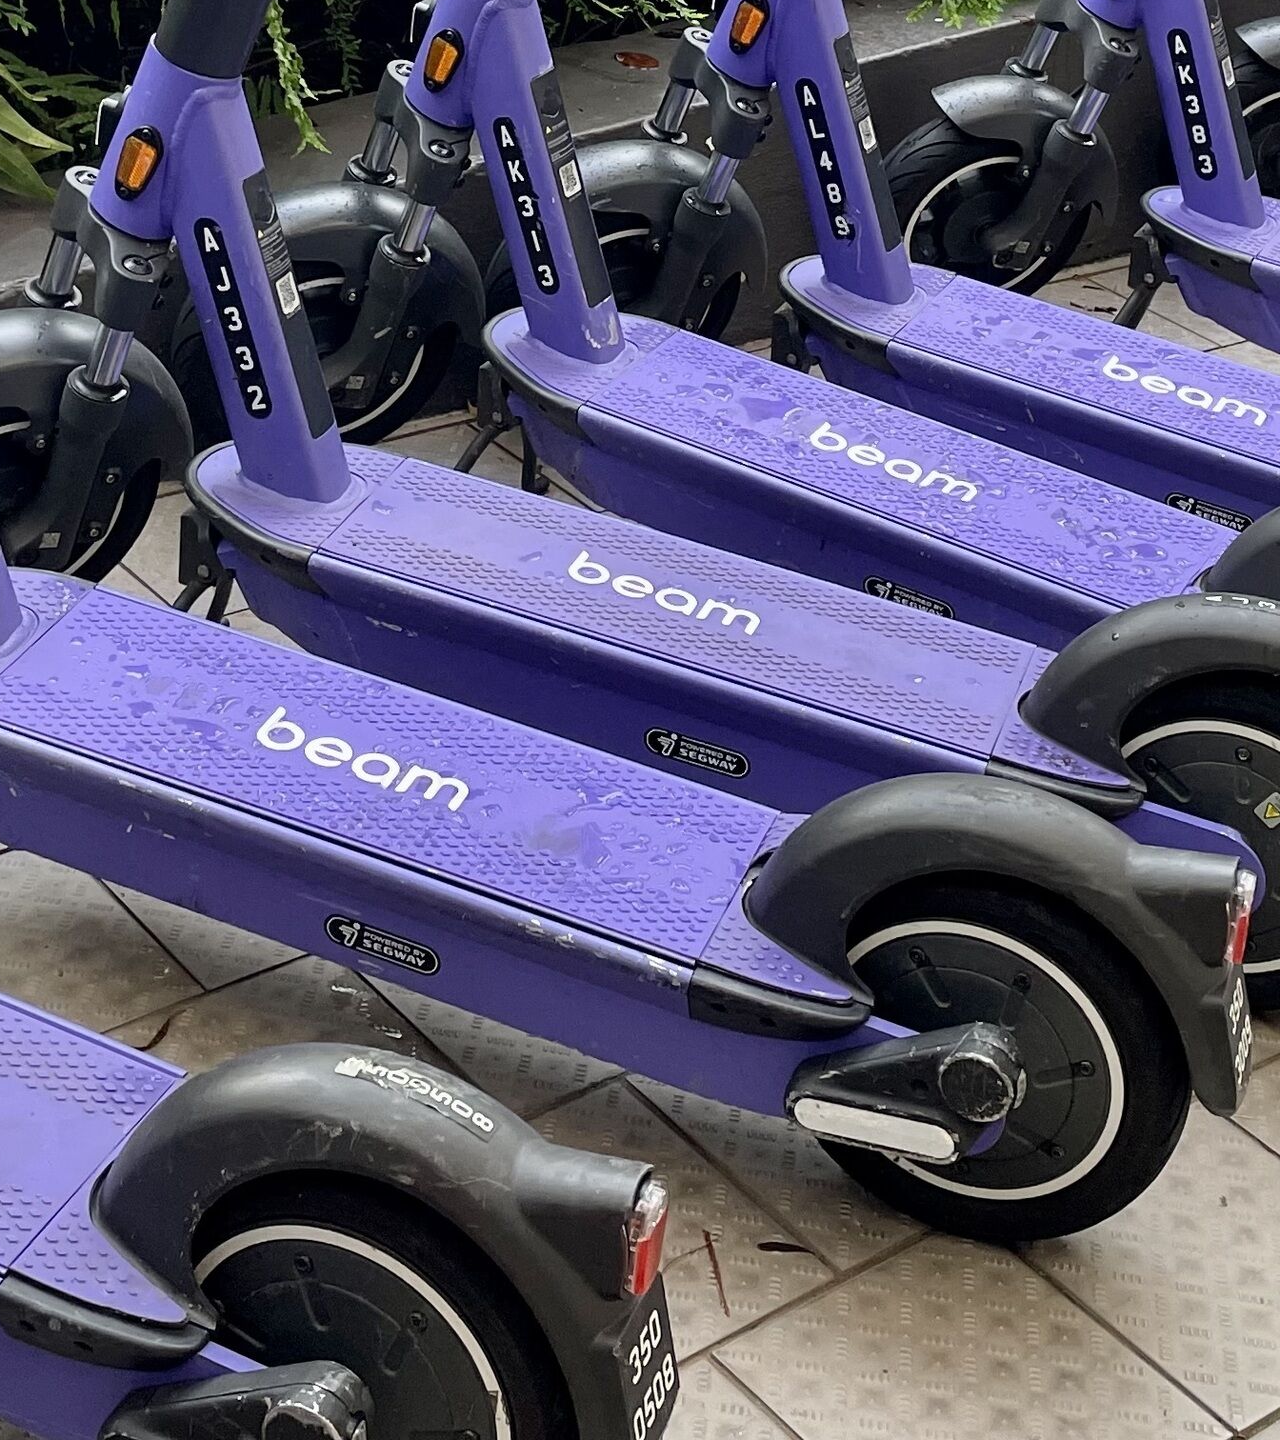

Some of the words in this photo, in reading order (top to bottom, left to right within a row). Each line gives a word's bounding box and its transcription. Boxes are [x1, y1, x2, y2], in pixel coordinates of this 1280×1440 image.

[1174, 34, 1213, 174] AK383
[803, 85, 851, 235] AL489
[203, 227, 267, 411] AJ332
[1102, 355, 1268, 427] beam
[809, 421, 978, 502] beam
[567, 550, 761, 636] beam
[256, 706, 470, 811] beam
[679, 748, 737, 771] SEGWAY
[680, 741, 724, 759] POWERED
[725, 754, 738, 763] BY
[362, 939, 426, 967] SEGWAY
[363, 931, 411, 953] POWERED
[413, 949, 426, 958] BY
[628, 1309, 662, 1385] 350
[633, 1352, 675, 1440] 0508
